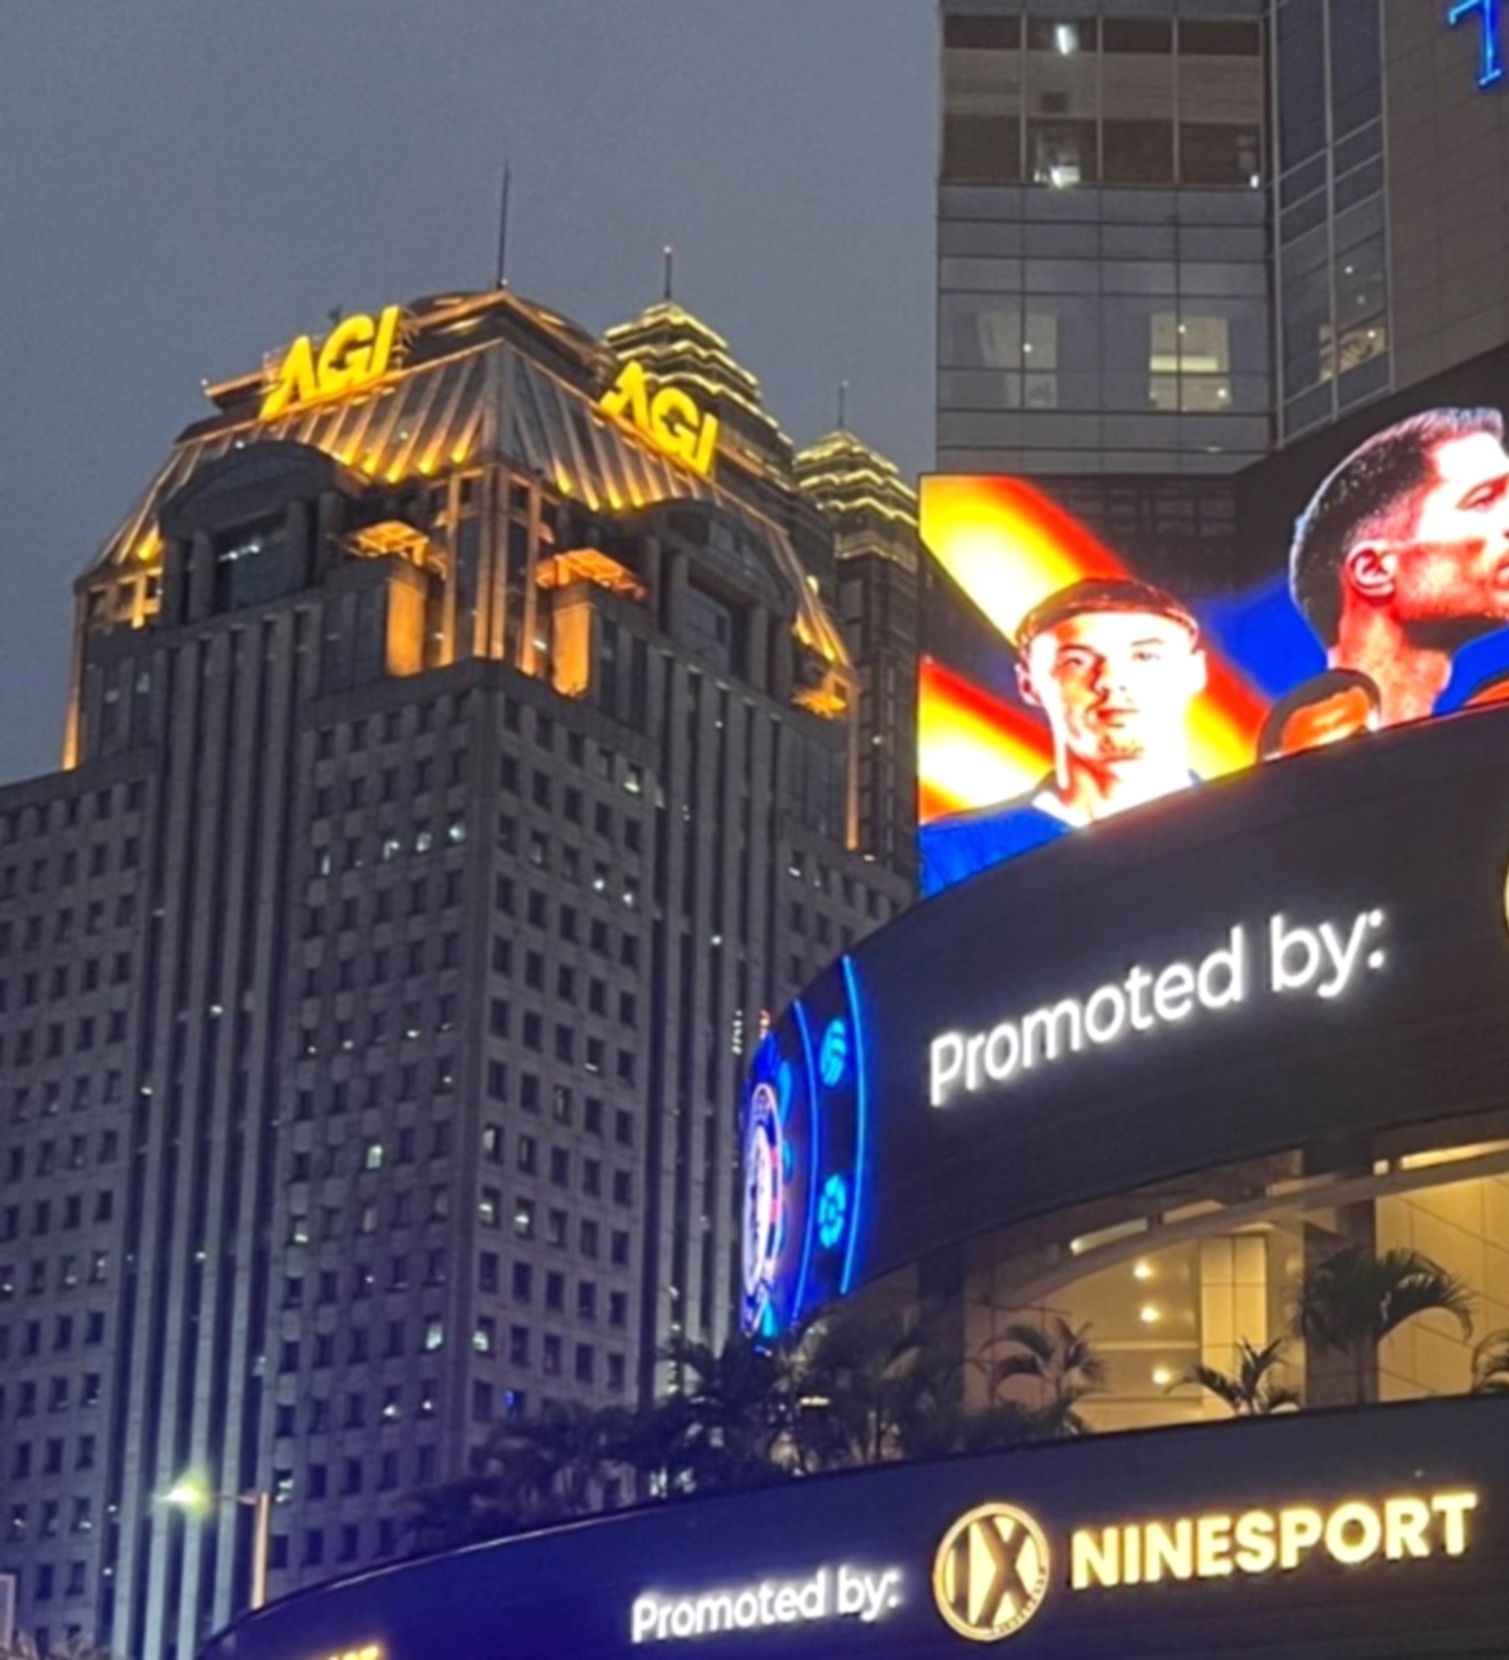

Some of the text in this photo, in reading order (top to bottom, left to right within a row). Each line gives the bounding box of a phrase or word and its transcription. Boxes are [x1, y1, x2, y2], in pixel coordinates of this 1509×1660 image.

[259, 304, 400, 422] AGI
[599, 359, 719, 476] AGI
[930, 908, 1385, 1107] Promoted by:
[1071, 1491, 1479, 1590] NINESPORT
[631, 1564, 903, 1644] Promoted by:
